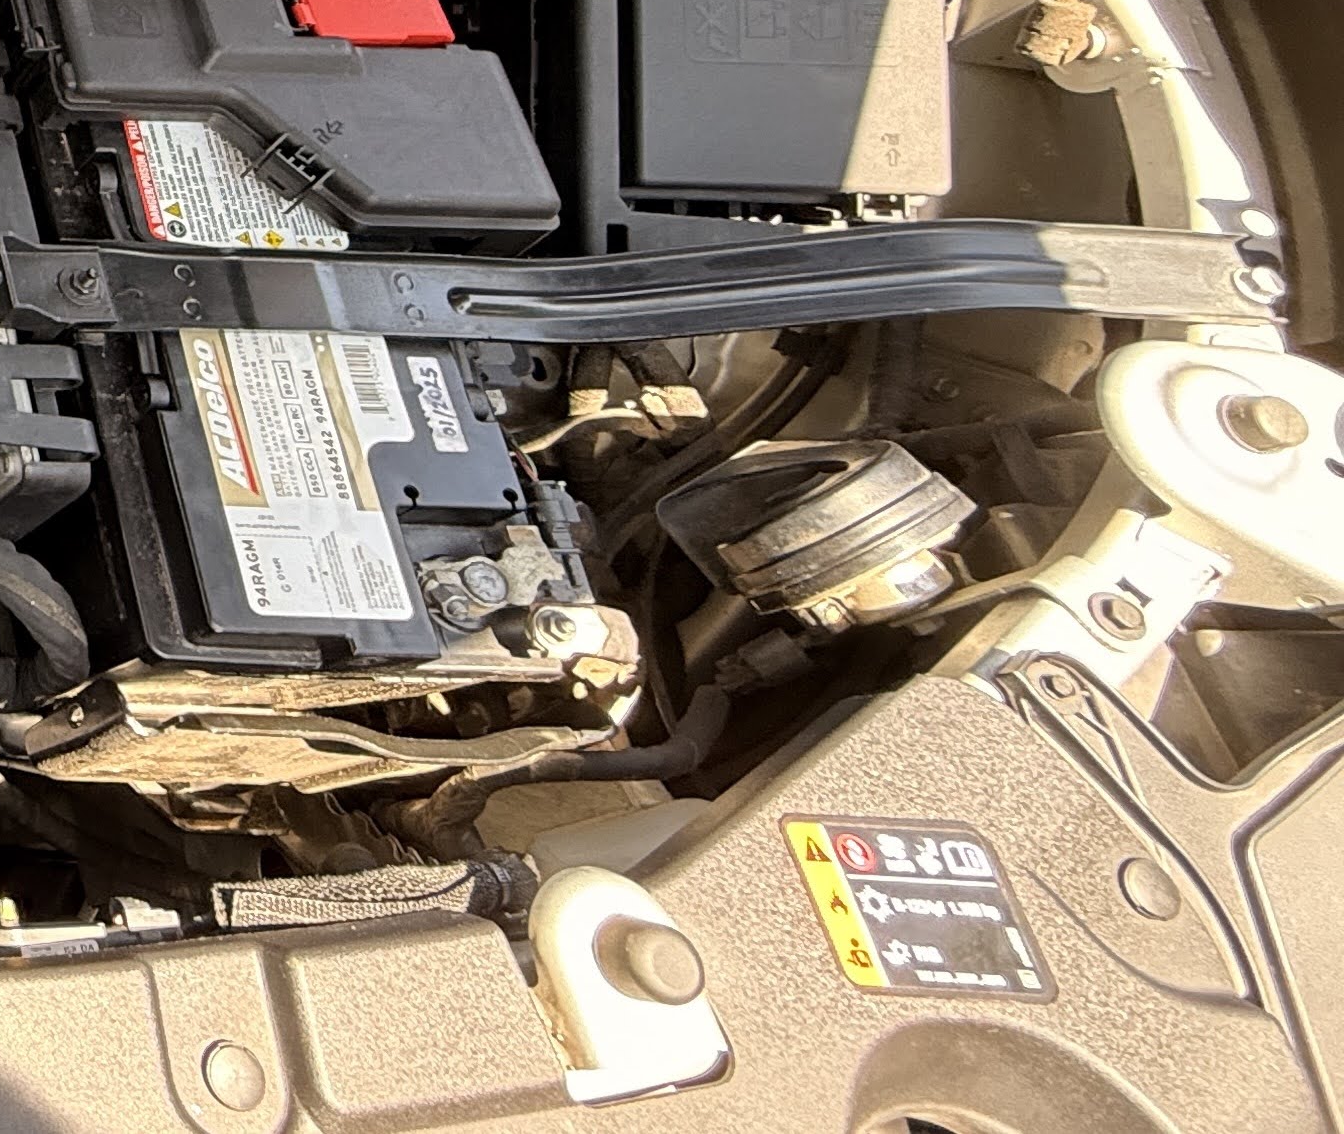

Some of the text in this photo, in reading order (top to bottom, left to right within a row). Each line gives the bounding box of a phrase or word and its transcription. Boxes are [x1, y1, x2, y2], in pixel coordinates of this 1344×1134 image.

[134, 154, 161, 223] DANGER/POISON
[193, 338, 248, 488] ACDelco
[282, 383, 293, 395] 80
[289, 407, 300, 419] RC
[301, 369, 327, 423] 94RAGM
[418, 367, 456, 435] 01/2025
[302, 452, 322, 493] 850 CCA
[319, 430, 350, 499] 88864542
[240, 539, 271, 607] 94RAGM
[279, 583, 292, 592] G
